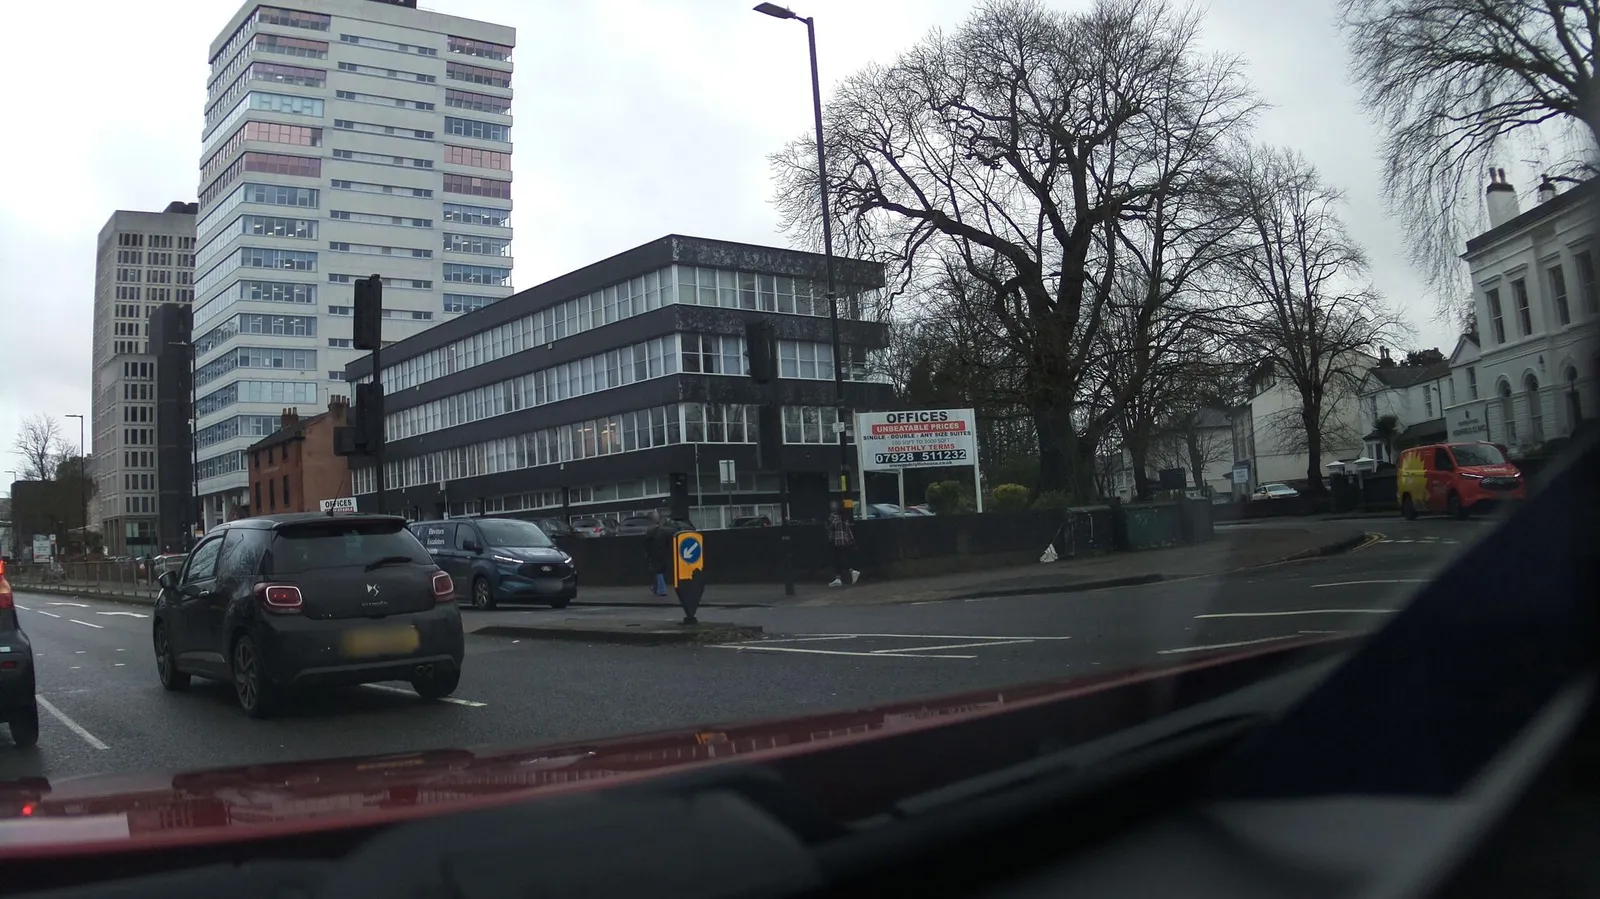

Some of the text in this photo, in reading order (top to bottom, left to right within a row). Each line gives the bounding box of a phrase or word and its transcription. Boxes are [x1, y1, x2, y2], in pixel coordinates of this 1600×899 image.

[886, 411, 948, 423] OFFICES
[877, 422, 960, 433] UNBEATABLE PRICES
[888, 443, 955, 453] MONTHLY TERMS
[876, 450, 967, 463] 07928 511232
